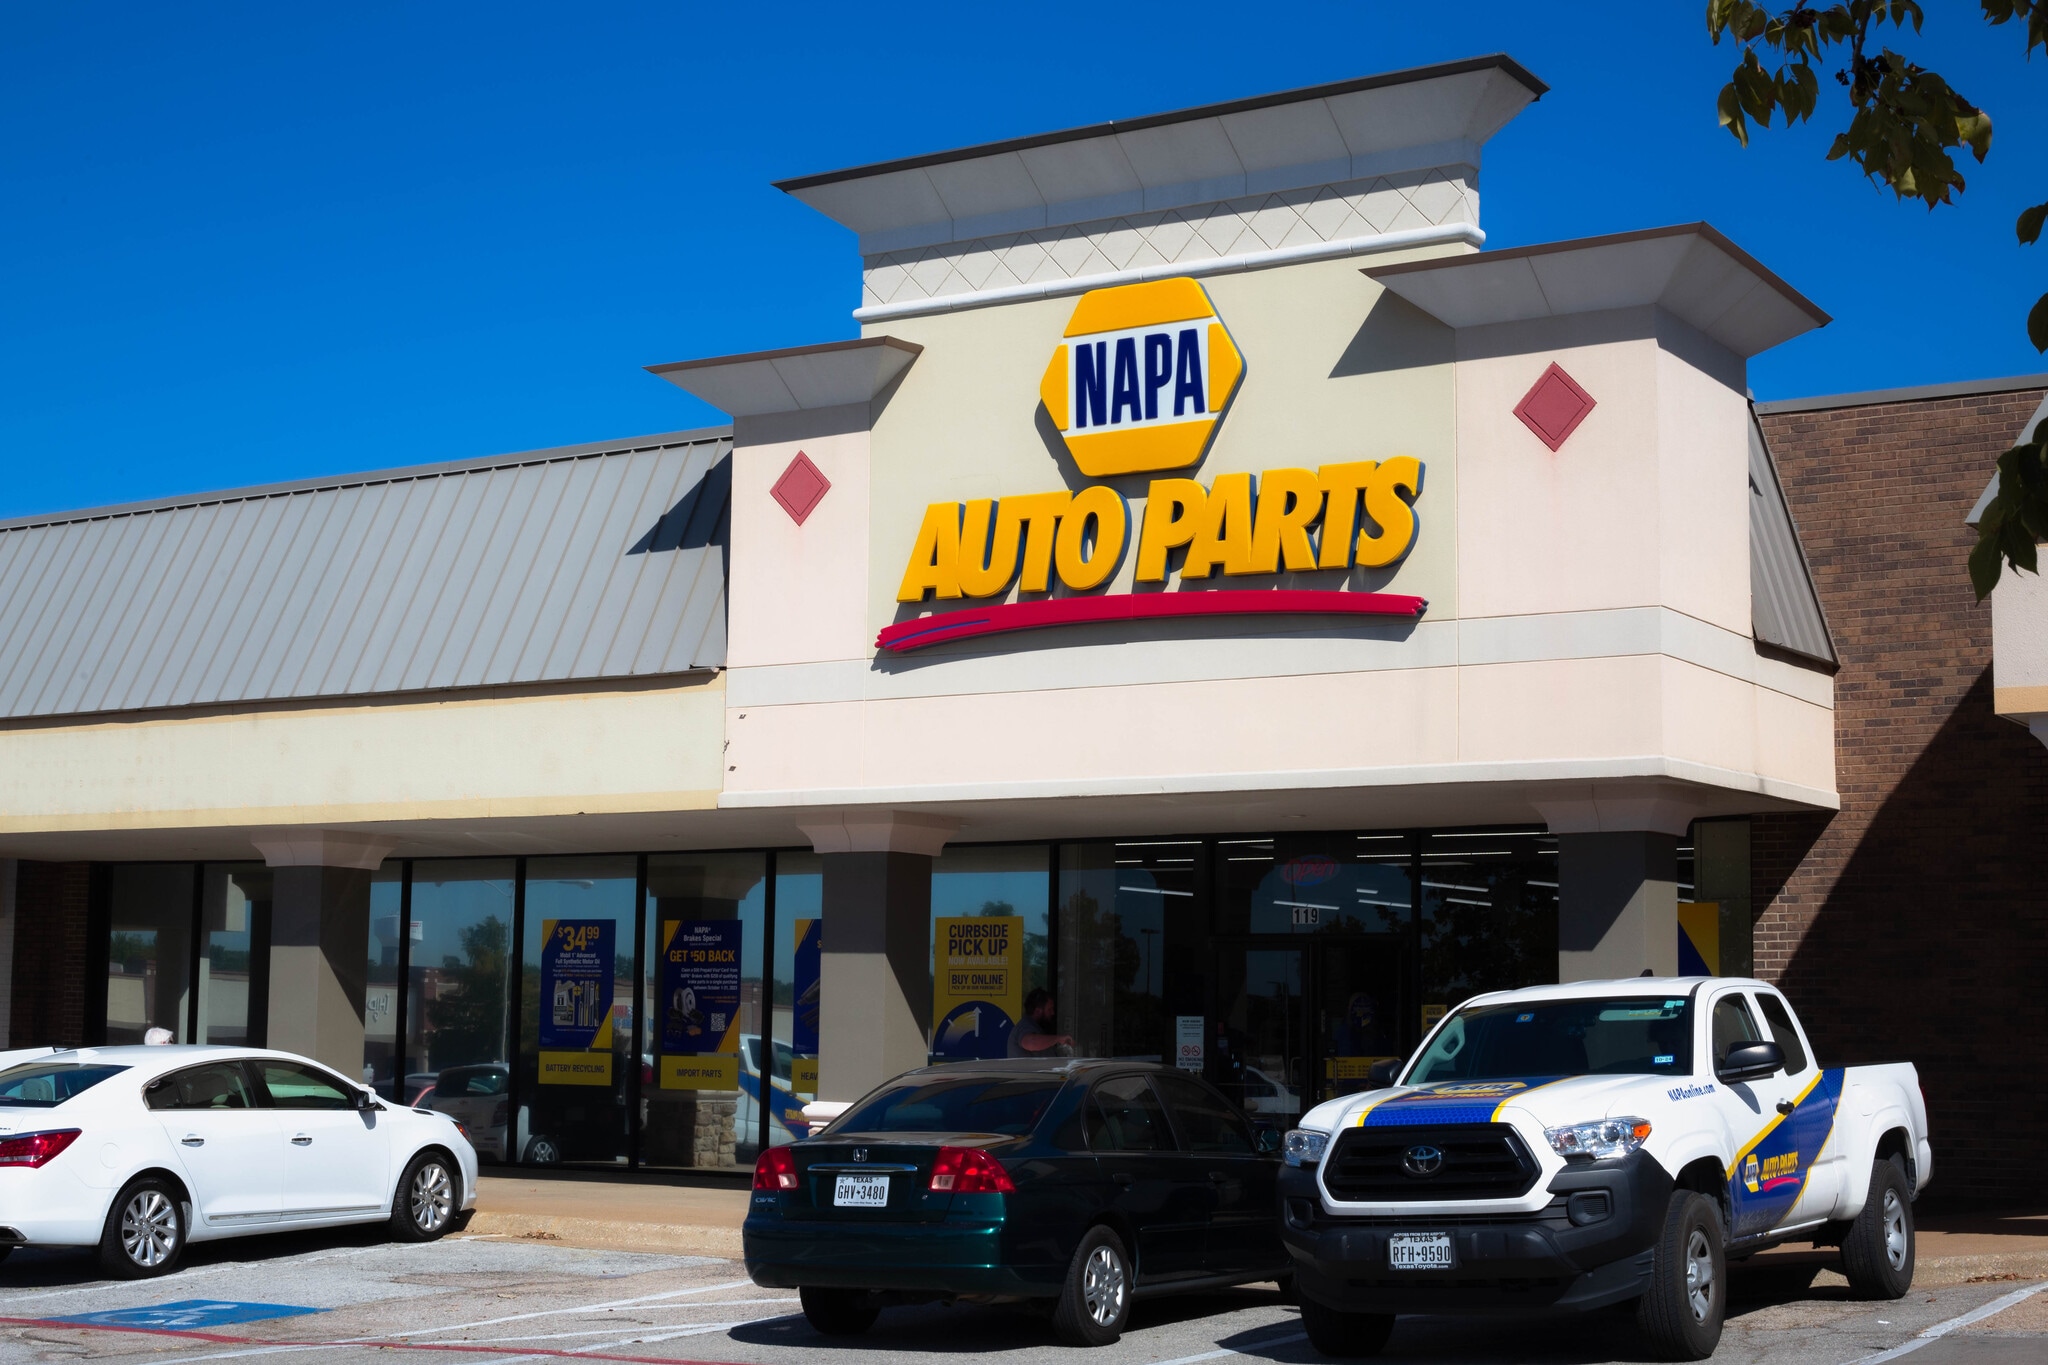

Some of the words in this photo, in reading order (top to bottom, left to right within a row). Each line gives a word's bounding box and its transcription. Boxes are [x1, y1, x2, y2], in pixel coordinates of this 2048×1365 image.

[1075, 328, 1206, 429] NAPA
[896, 485, 1127, 603] AUTO
[1135, 455, 1424, 584] PARTS
[1295, 909, 1318, 923] 119
[949, 924, 1008, 938] CURBSIDE
[683, 934, 701, 942] Brakes
[703, 934, 722, 943] Special
[949, 939, 983, 956] PICK
[988, 939, 1008, 956] UP
[670, 949, 688, 962] GET
[690, 949, 706, 962] $50
[707, 949, 735, 962] BACK
[949, 956, 964, 966] NOW
[952, 974, 968, 985] BUY
[972, 974, 1003, 985] ONLINE
[546, 1063, 571, 1072] BATTERY
[572, 1064, 605, 1073] RECYCLING
[677, 1068, 700, 1078] IMPORT
[701, 1069, 722, 1078] PARTS
[1667, 1083, 1716, 1102] NAPAonline.com
[1761, 1155, 1780, 1181] AUTO
[1777, 1151, 1799, 1177] PARTS
